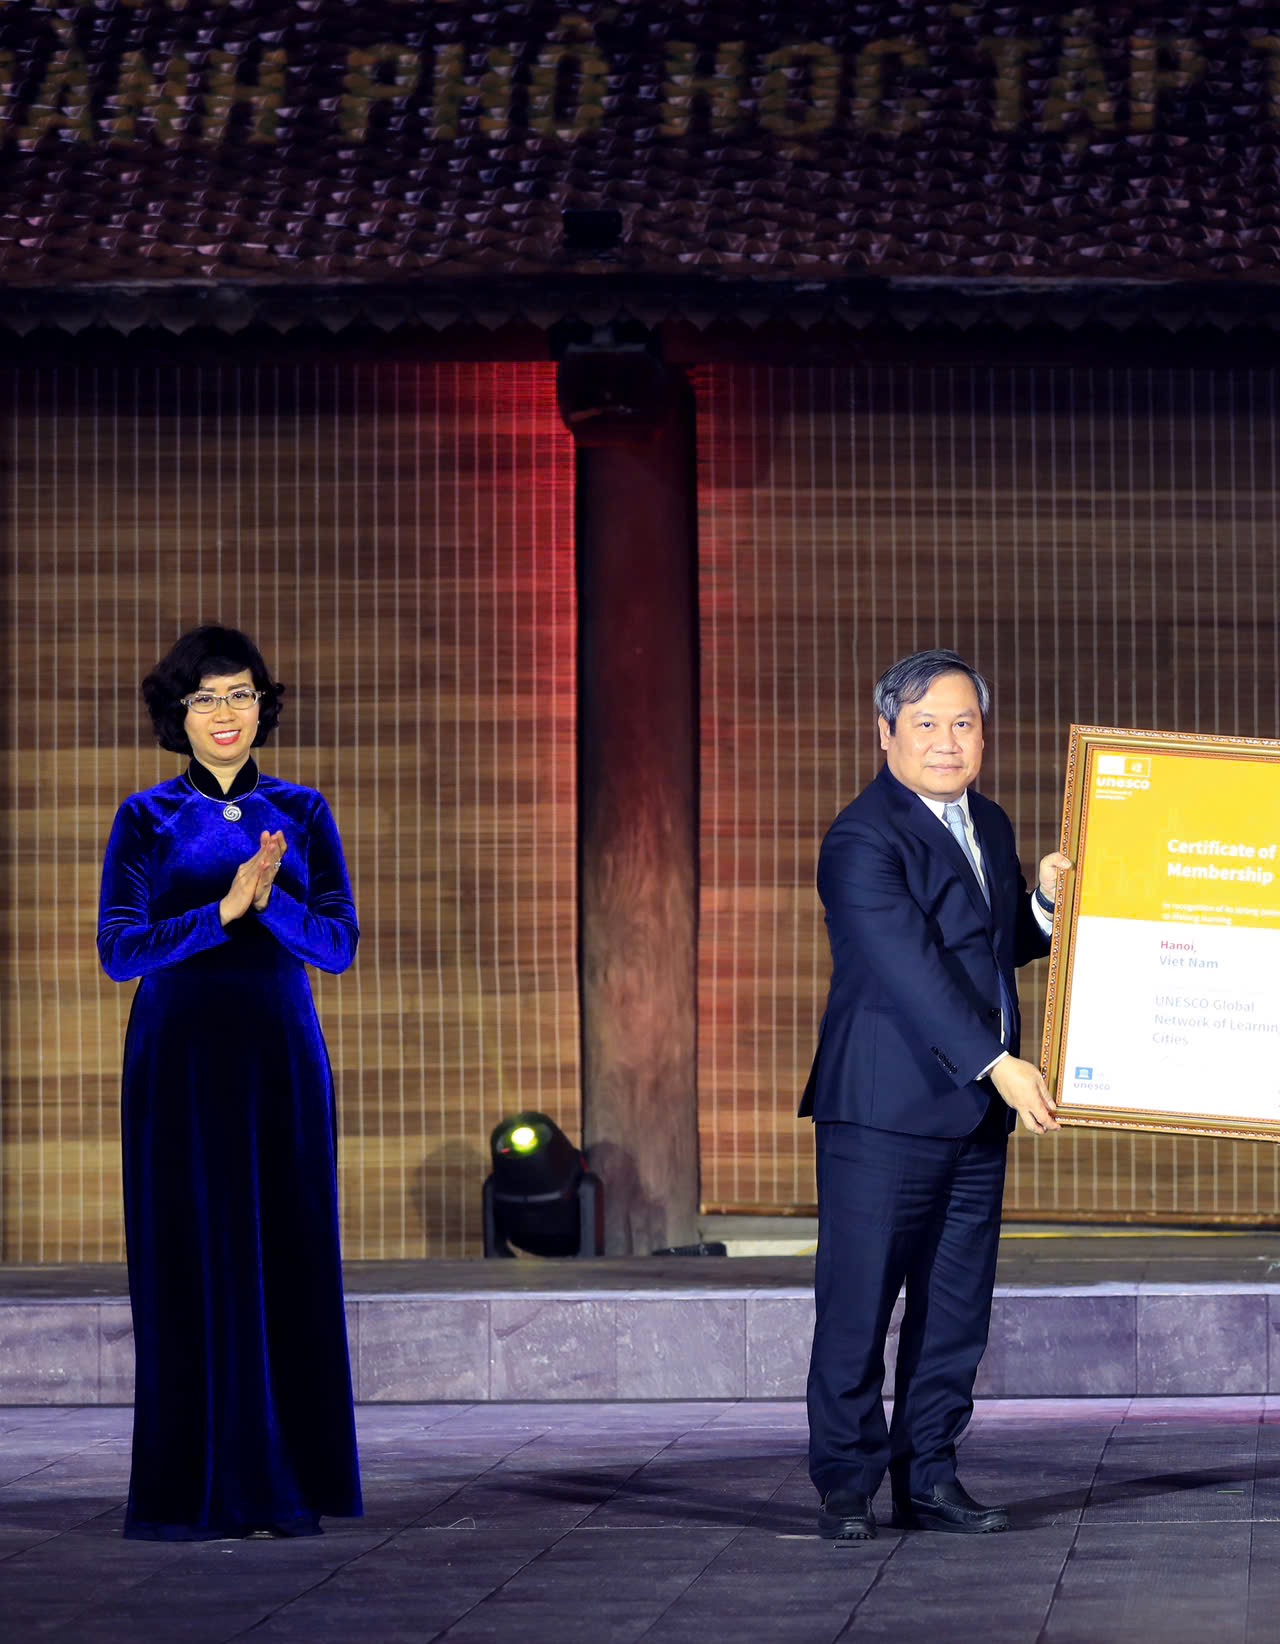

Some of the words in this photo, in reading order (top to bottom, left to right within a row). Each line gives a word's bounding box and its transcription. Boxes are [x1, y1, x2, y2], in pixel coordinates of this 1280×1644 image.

[0, 16, 287, 147] ÀNH
[660, 39, 928, 160] HỌC
[1096, 777, 1151, 791] unesco
[1167, 839, 1255, 859] Certificate
[1257, 843, 1278, 861] of
[1167, 863, 1275, 886] Membership
[1160, 939, 1196, 954] Hanoi,
[1159, 953, 1184, 967] Viet
[1188, 957, 1218, 969] Nam
[1154, 994, 1209, 1009] UNESCO
[1213, 999, 1255, 1013] Global
[1154, 1014, 1209, 1027] Network
[1213, 1017, 1227, 1030] of
[1152, 1032, 1188, 1046] Cities
[1073, 1082, 1111, 1091] unesco
